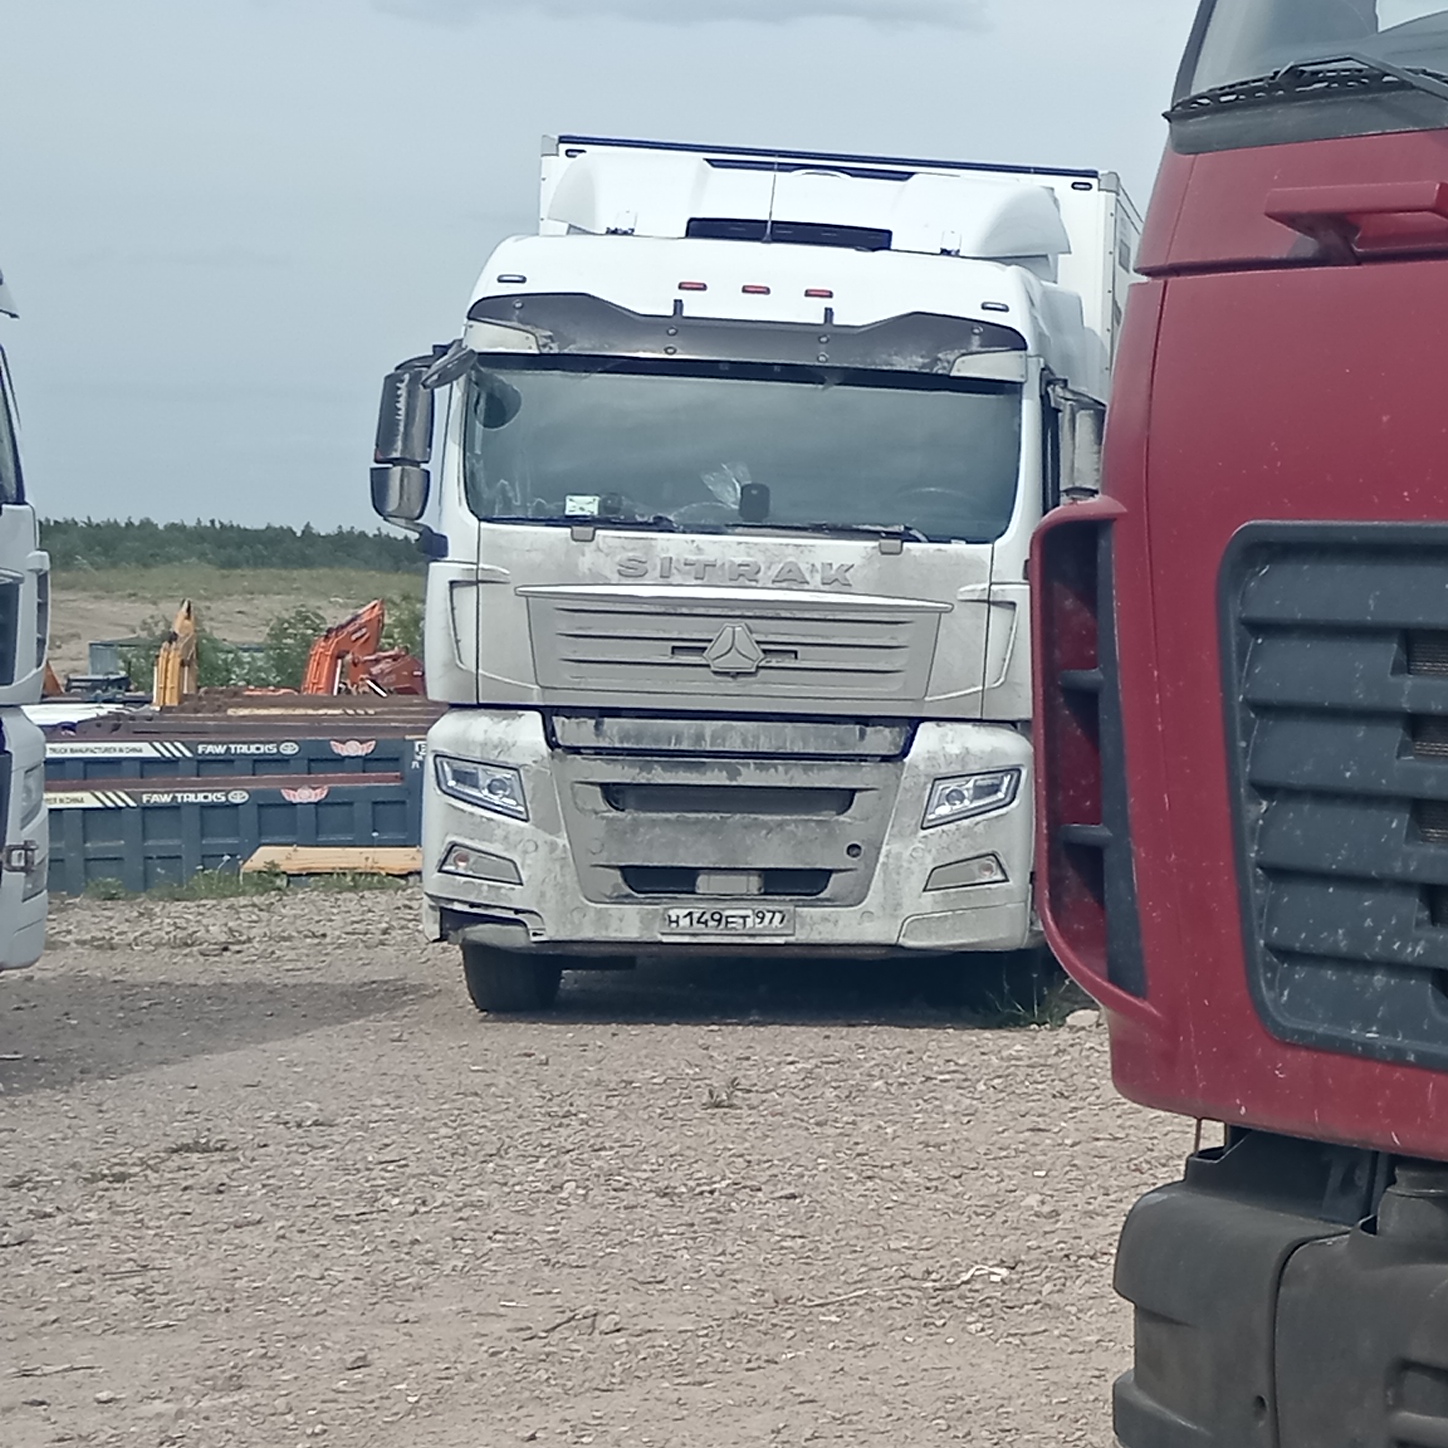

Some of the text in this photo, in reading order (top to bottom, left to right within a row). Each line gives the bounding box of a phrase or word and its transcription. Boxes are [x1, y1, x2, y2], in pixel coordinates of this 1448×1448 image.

[616, 555, 855, 587] SITRAK
[197, 742, 277, 754] FAW TRUCKS
[142, 791, 226, 803] FAW TRUCKS
